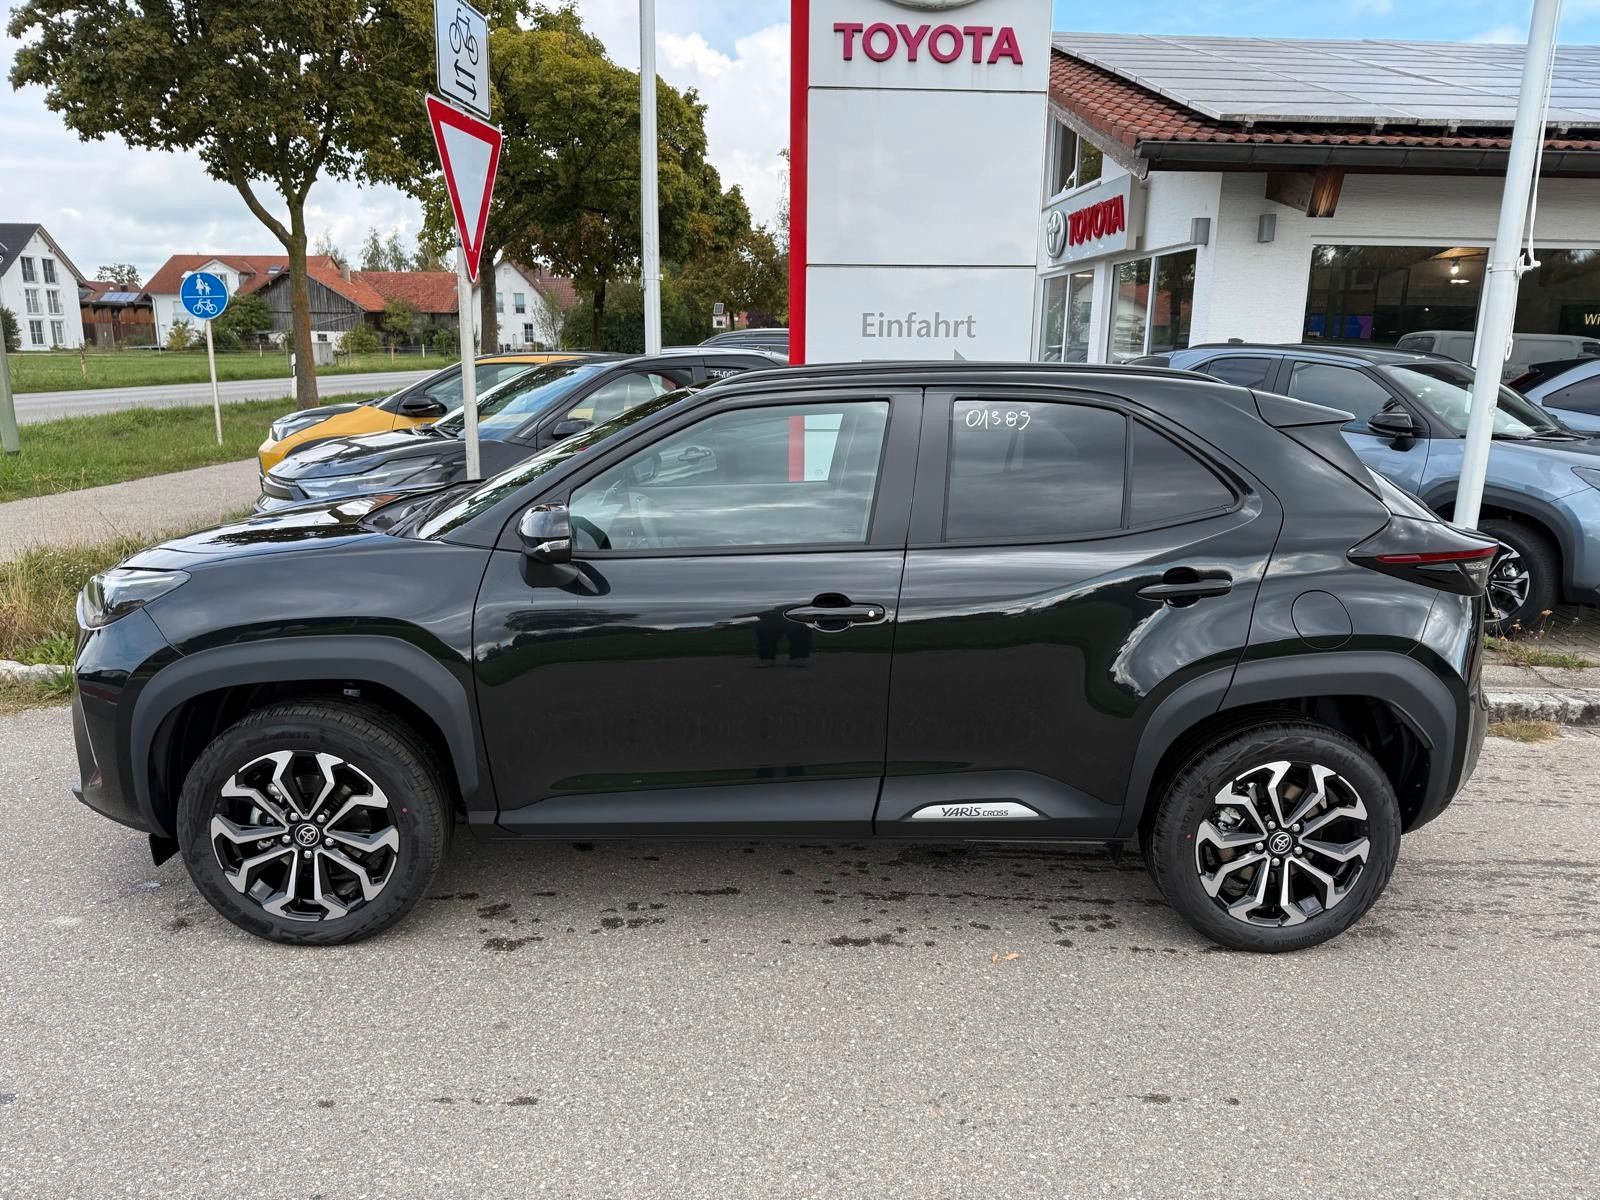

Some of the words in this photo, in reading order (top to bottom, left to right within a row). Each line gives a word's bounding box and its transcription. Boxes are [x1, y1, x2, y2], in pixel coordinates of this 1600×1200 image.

[833, 22, 1023, 65] TOYOTA
[1068, 195, 1125, 247] TOYOTA
[861, 311, 977, 338] Einfahrt
